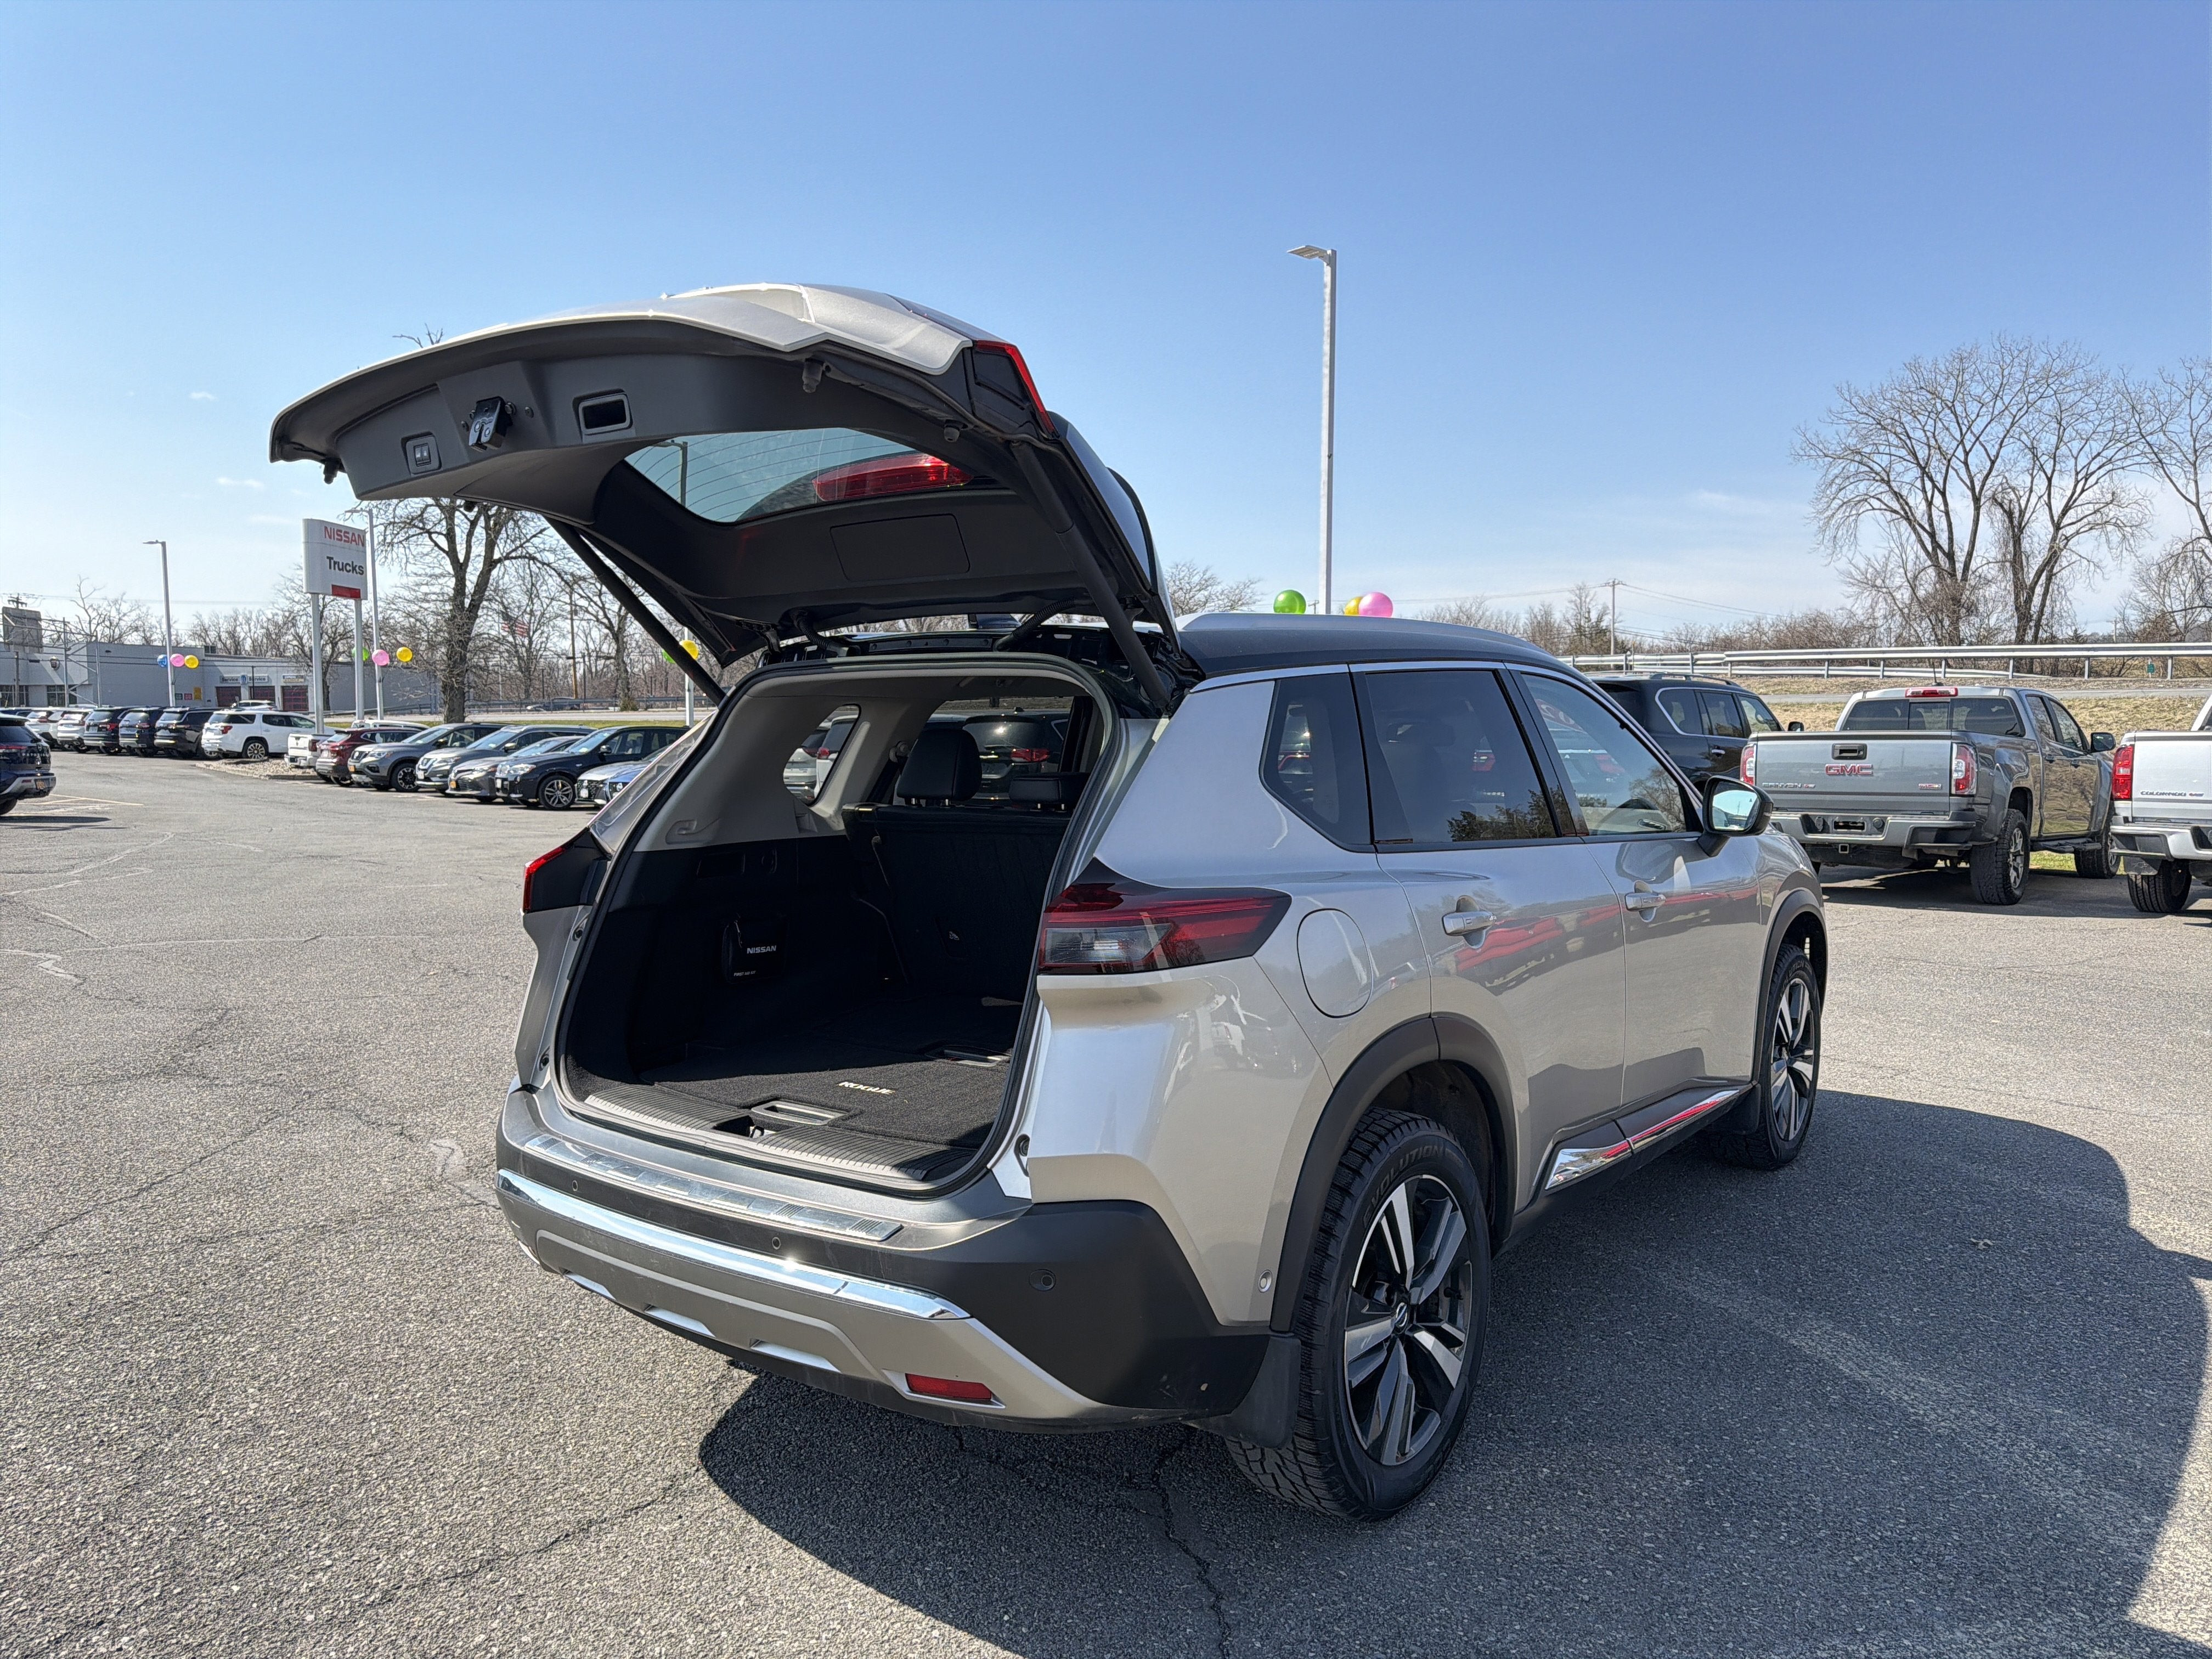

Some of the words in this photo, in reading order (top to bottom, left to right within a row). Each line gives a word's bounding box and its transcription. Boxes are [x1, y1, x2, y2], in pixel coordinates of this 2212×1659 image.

[324, 526, 365, 548] NISSAN
[326, 556, 364, 575] Trucks
[1825, 764, 1872, 775] GMC
[747, 945, 777, 954] NISSAN
[836, 1081, 896, 1094] ROGUE
[1363, 1145, 1443, 1228] EVOLUTION
